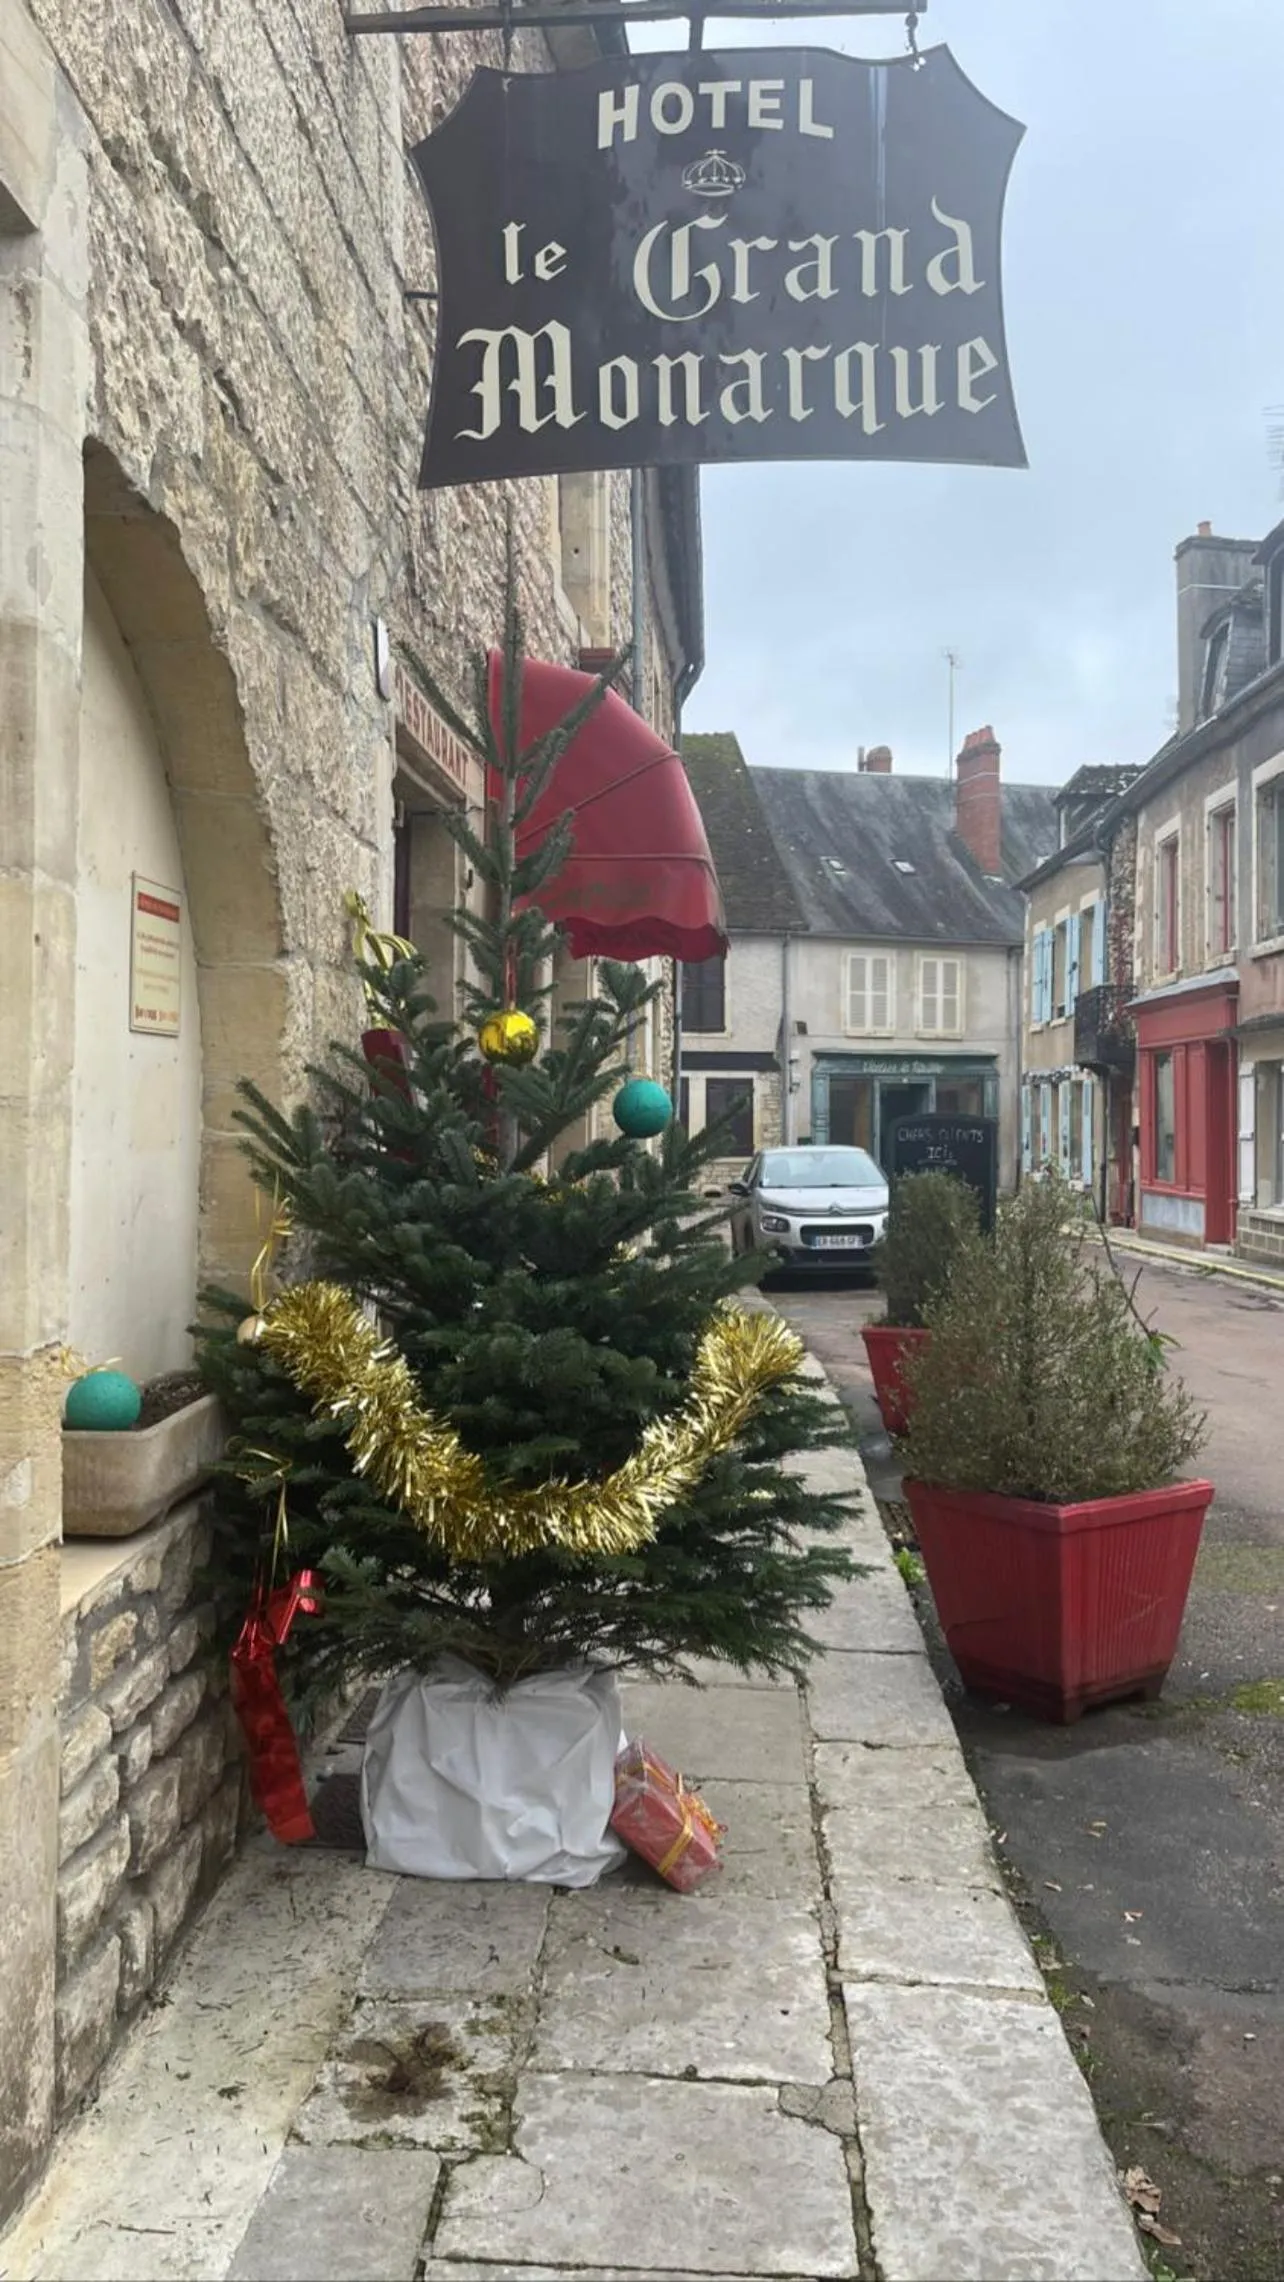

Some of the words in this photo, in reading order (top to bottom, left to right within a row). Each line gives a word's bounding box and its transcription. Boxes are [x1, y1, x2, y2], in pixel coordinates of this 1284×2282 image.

[597, 78, 835, 150] HOTEL
[502, 219, 569, 286] le
[632, 194, 987, 323] Grand
[452, 317, 1001, 441] Monarque
